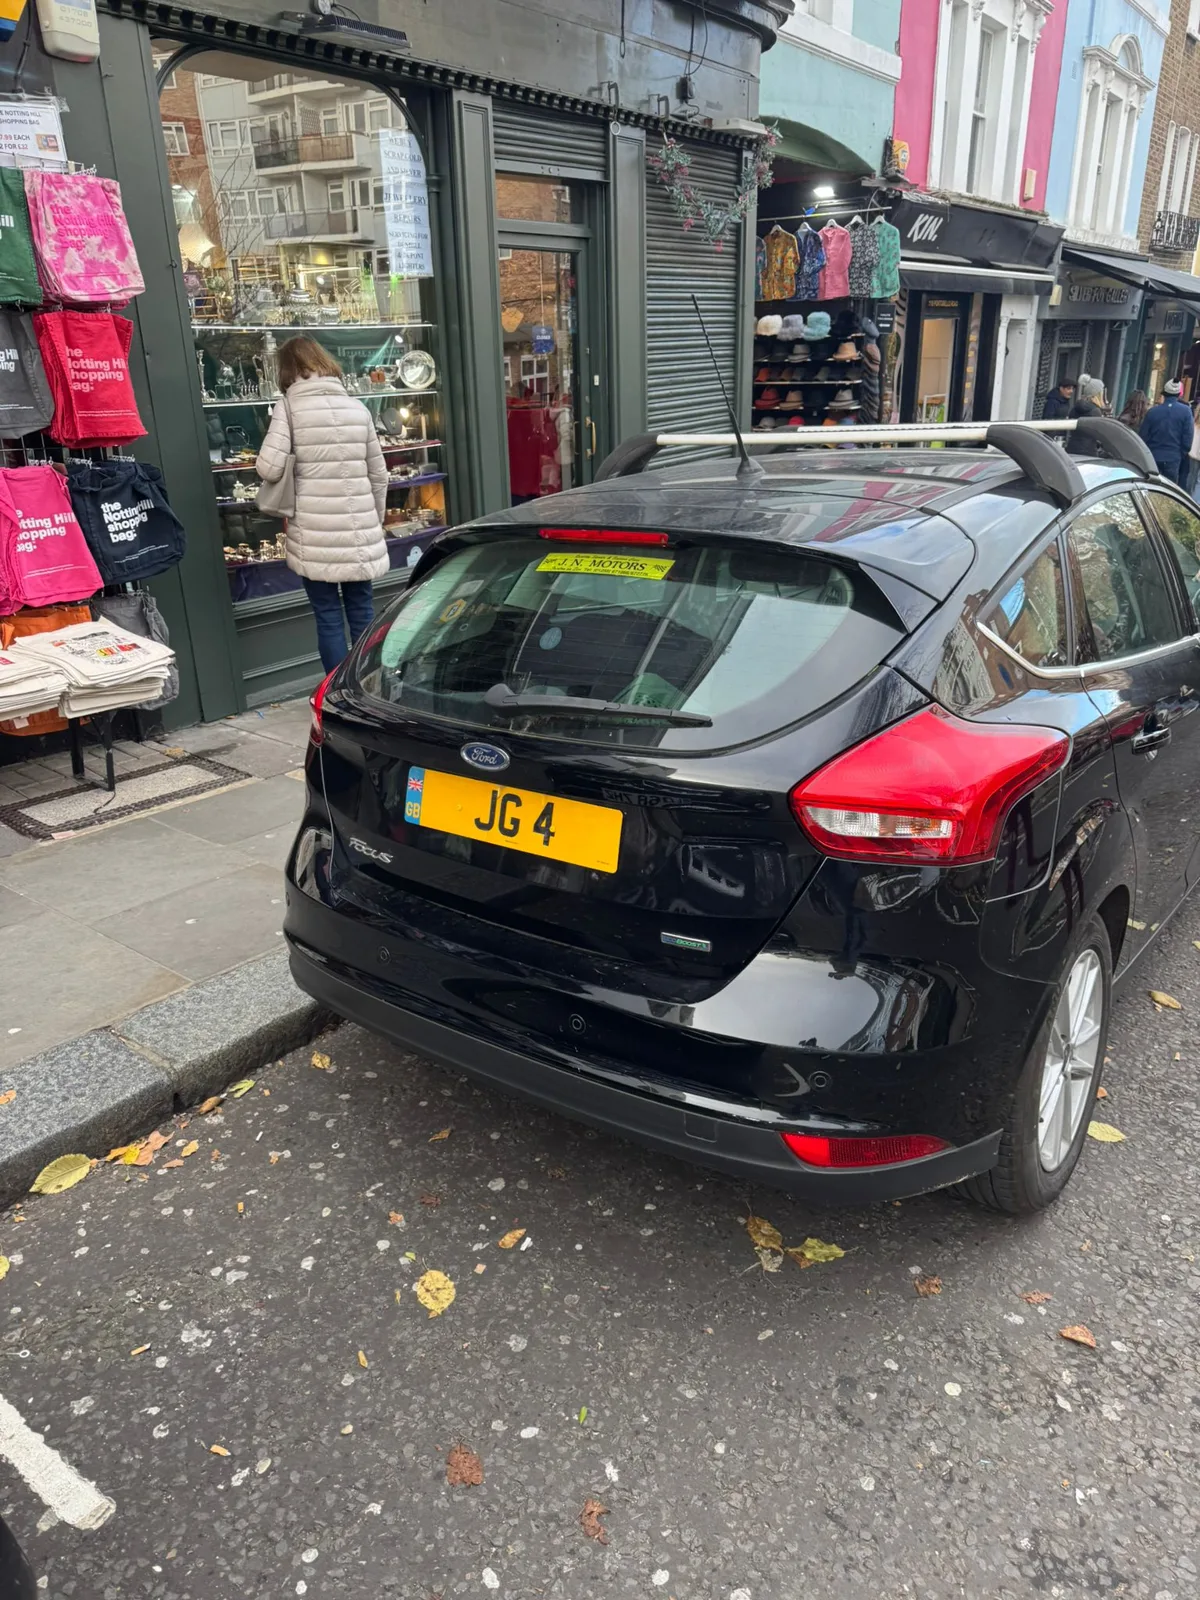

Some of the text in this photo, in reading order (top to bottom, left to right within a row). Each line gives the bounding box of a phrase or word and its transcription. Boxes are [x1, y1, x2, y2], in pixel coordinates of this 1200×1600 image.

[384, 193, 427, 206] JEWELLERY
[0, 214, 14, 228] ill
[53, 214, 97, 228] Notting
[393, 213, 422, 224] REPAIRS
[65, 346, 83, 357] he
[71, 369, 124, 382] hopping
[72, 382, 95, 393] ag:
[100, 502, 122, 513] the
[18, 511, 77, 529] tting Hill
[103, 507, 139, 524] Nottin
[17, 526, 66, 541] opping
[109, 529, 137, 544] bag:
[589, 559, 648, 571] MOTORS
[471, 747, 498, 765] Ford
[405, 801, 420, 818] GB
[474, 789, 555, 846] JG 4
